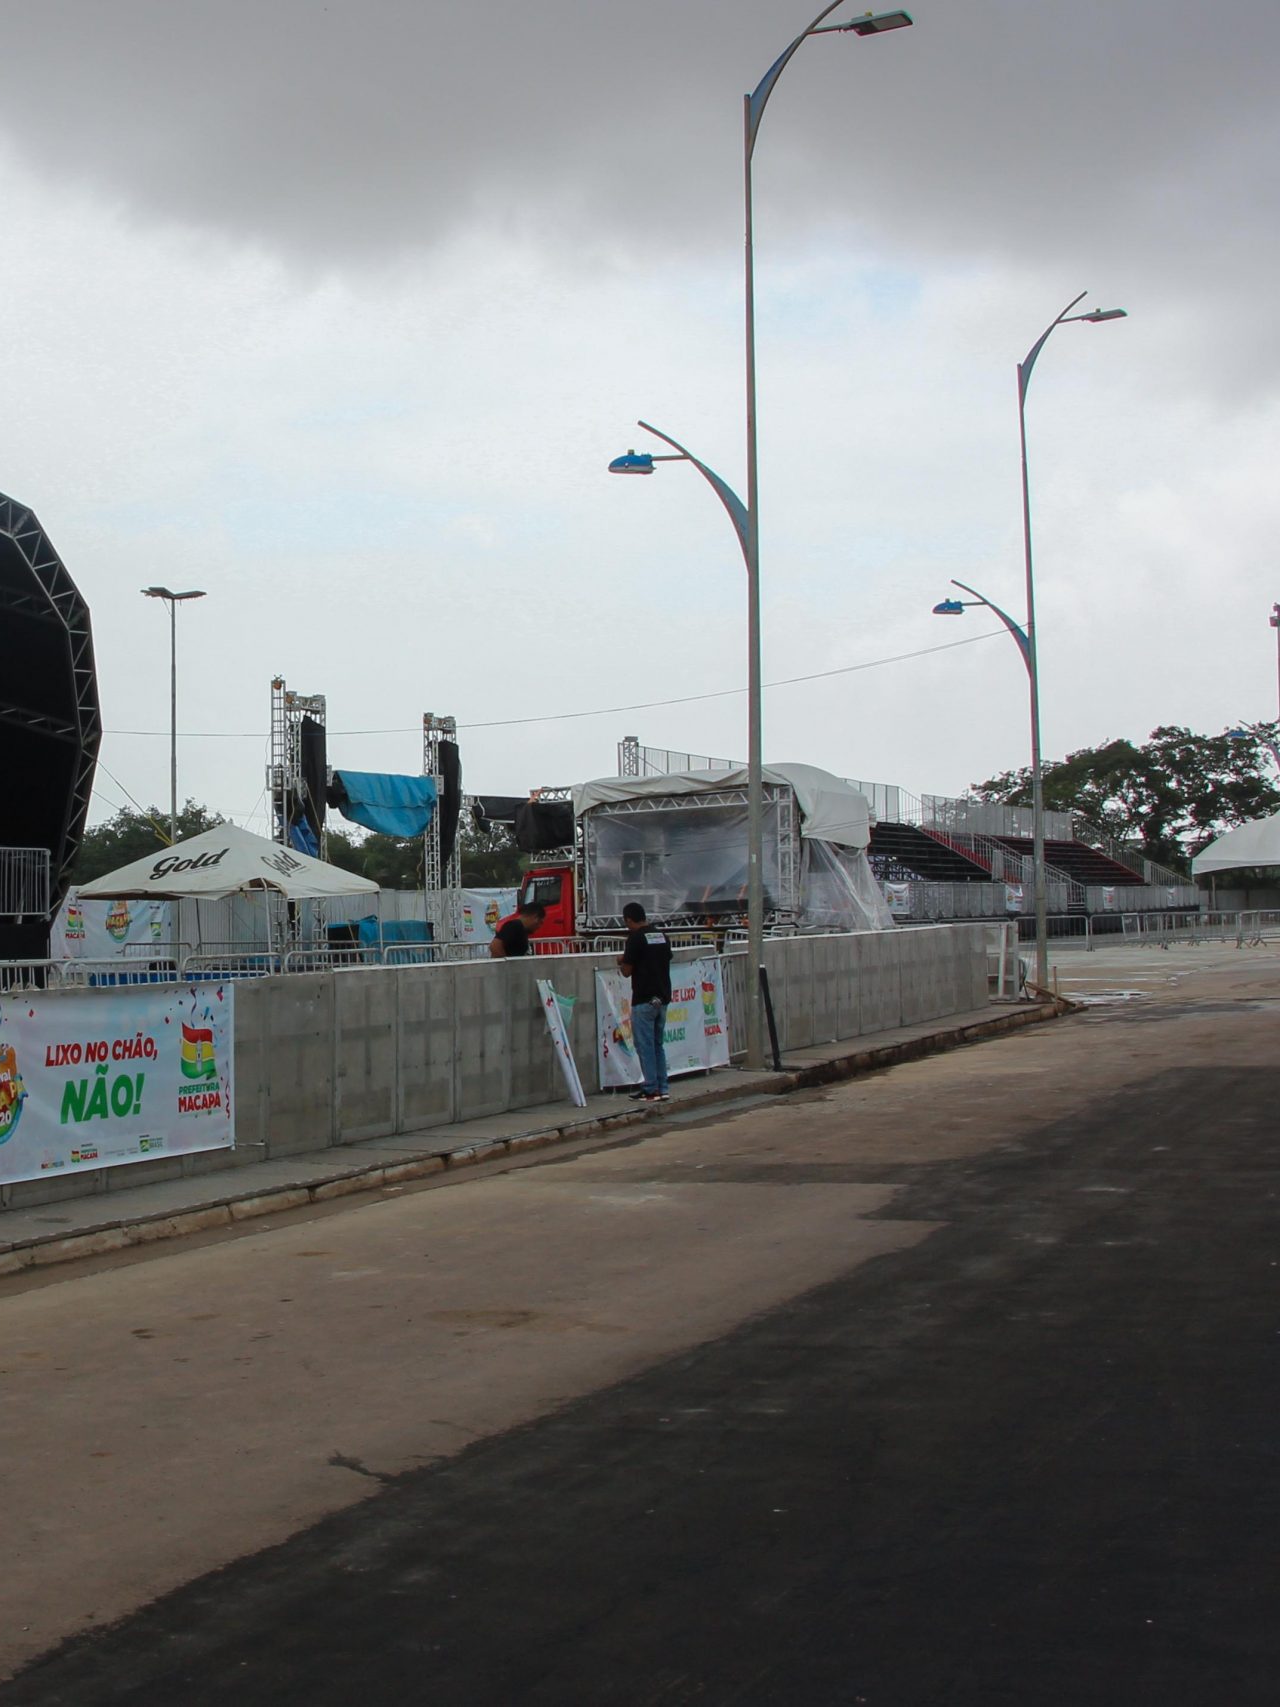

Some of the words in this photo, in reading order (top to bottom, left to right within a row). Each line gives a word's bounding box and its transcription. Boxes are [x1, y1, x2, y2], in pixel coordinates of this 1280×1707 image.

[149, 848, 230, 880] Gold
[260, 850, 302, 878] Gold
[680, 987, 696, 1001] LIXO
[45, 1043, 82, 1067] LIXO
[84, 1041, 109, 1063] NO
[112, 1032, 158, 1061] CHÃO,
[61, 1064, 145, 1125] NÃO!
[178, 1082, 220, 1096] PREFEITURA
